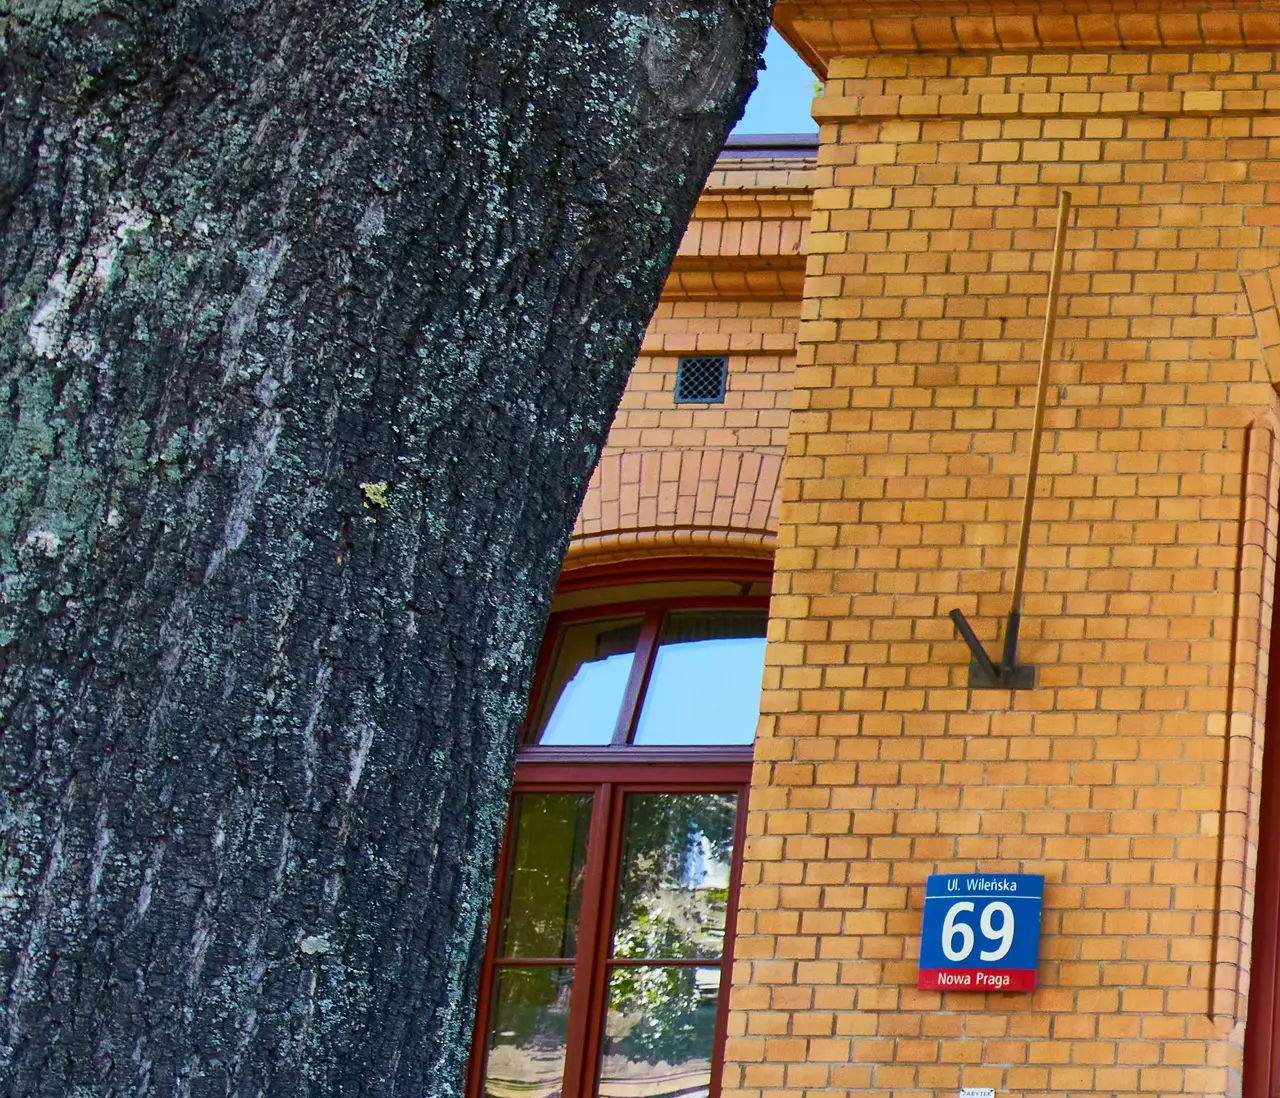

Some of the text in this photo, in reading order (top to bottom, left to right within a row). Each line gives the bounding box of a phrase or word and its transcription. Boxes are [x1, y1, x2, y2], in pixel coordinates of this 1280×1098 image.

[947, 878, 1017, 891] Ul. Wileńska
[942, 901, 1015, 962] 69
[938, 972, 1010, 988] Nowa Praga
